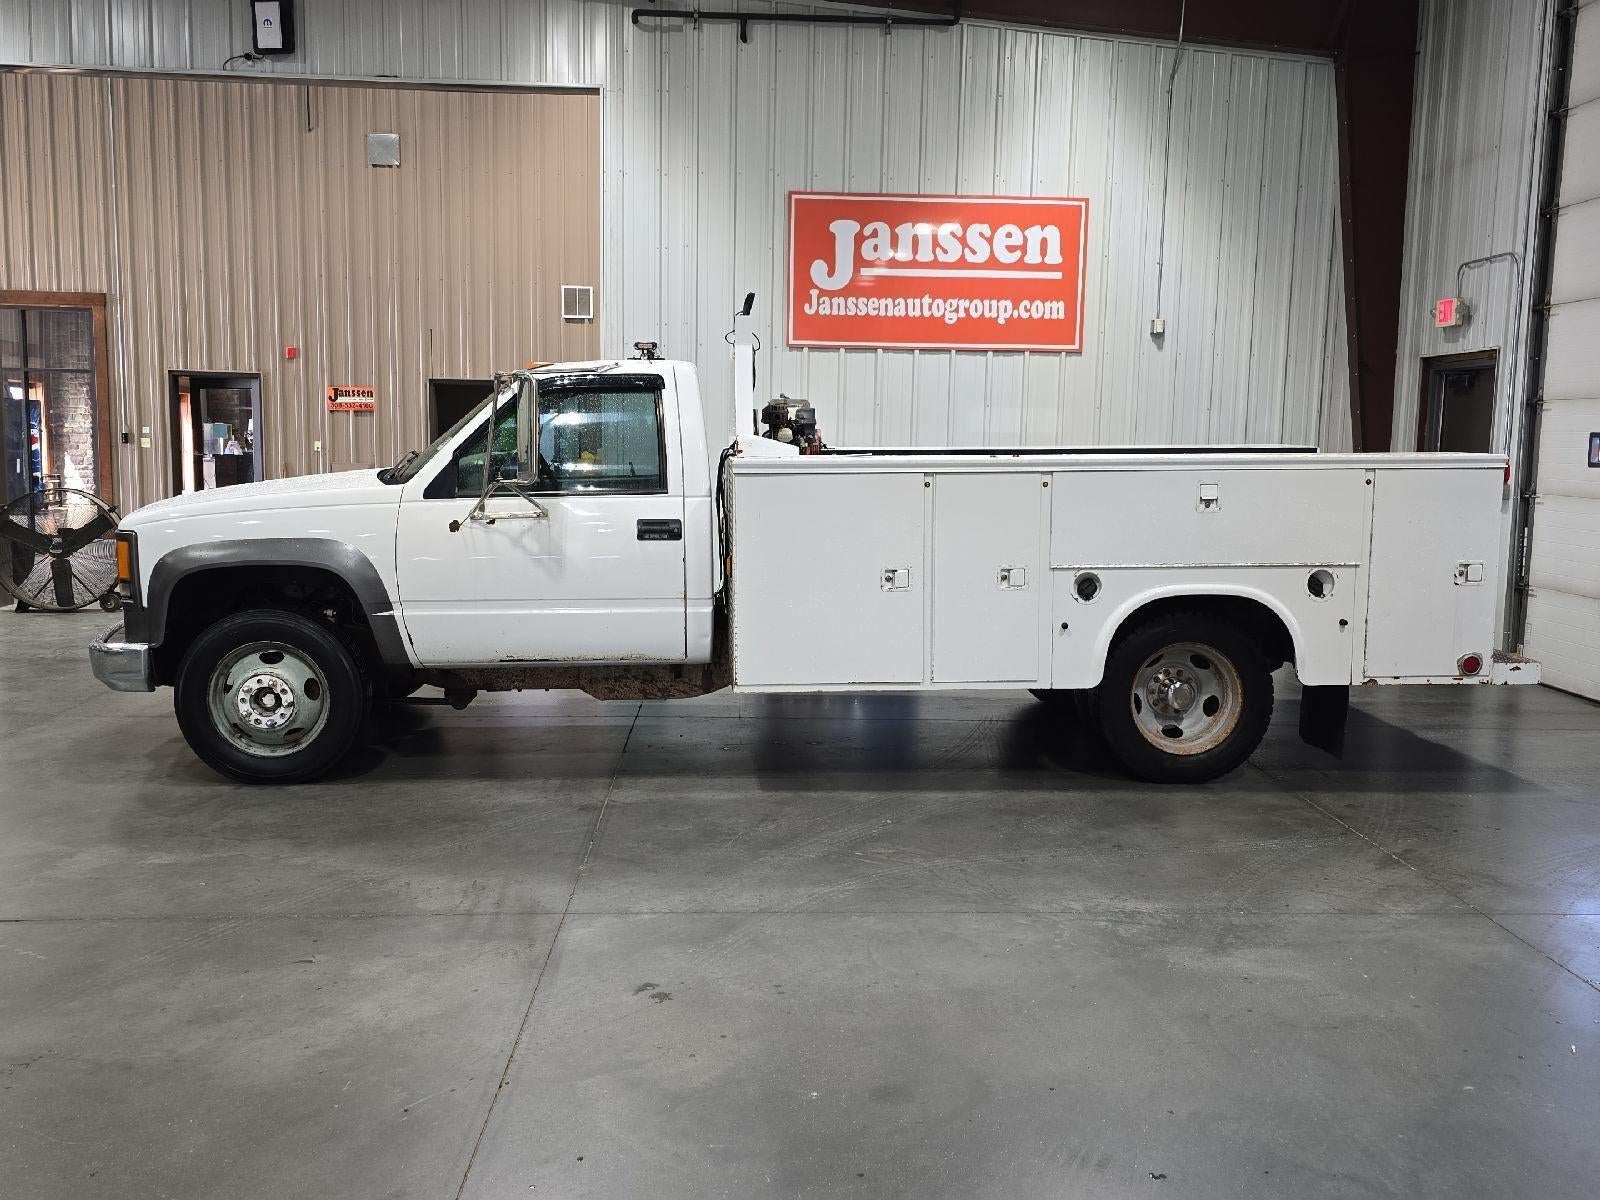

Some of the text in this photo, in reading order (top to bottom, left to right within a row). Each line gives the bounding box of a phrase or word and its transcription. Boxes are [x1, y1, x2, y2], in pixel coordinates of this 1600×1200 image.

[809, 219, 1063, 291] Janssen
[803, 288, 1065, 325] Janssenautogroup.com
[328, 387, 374, 402] Janssen
